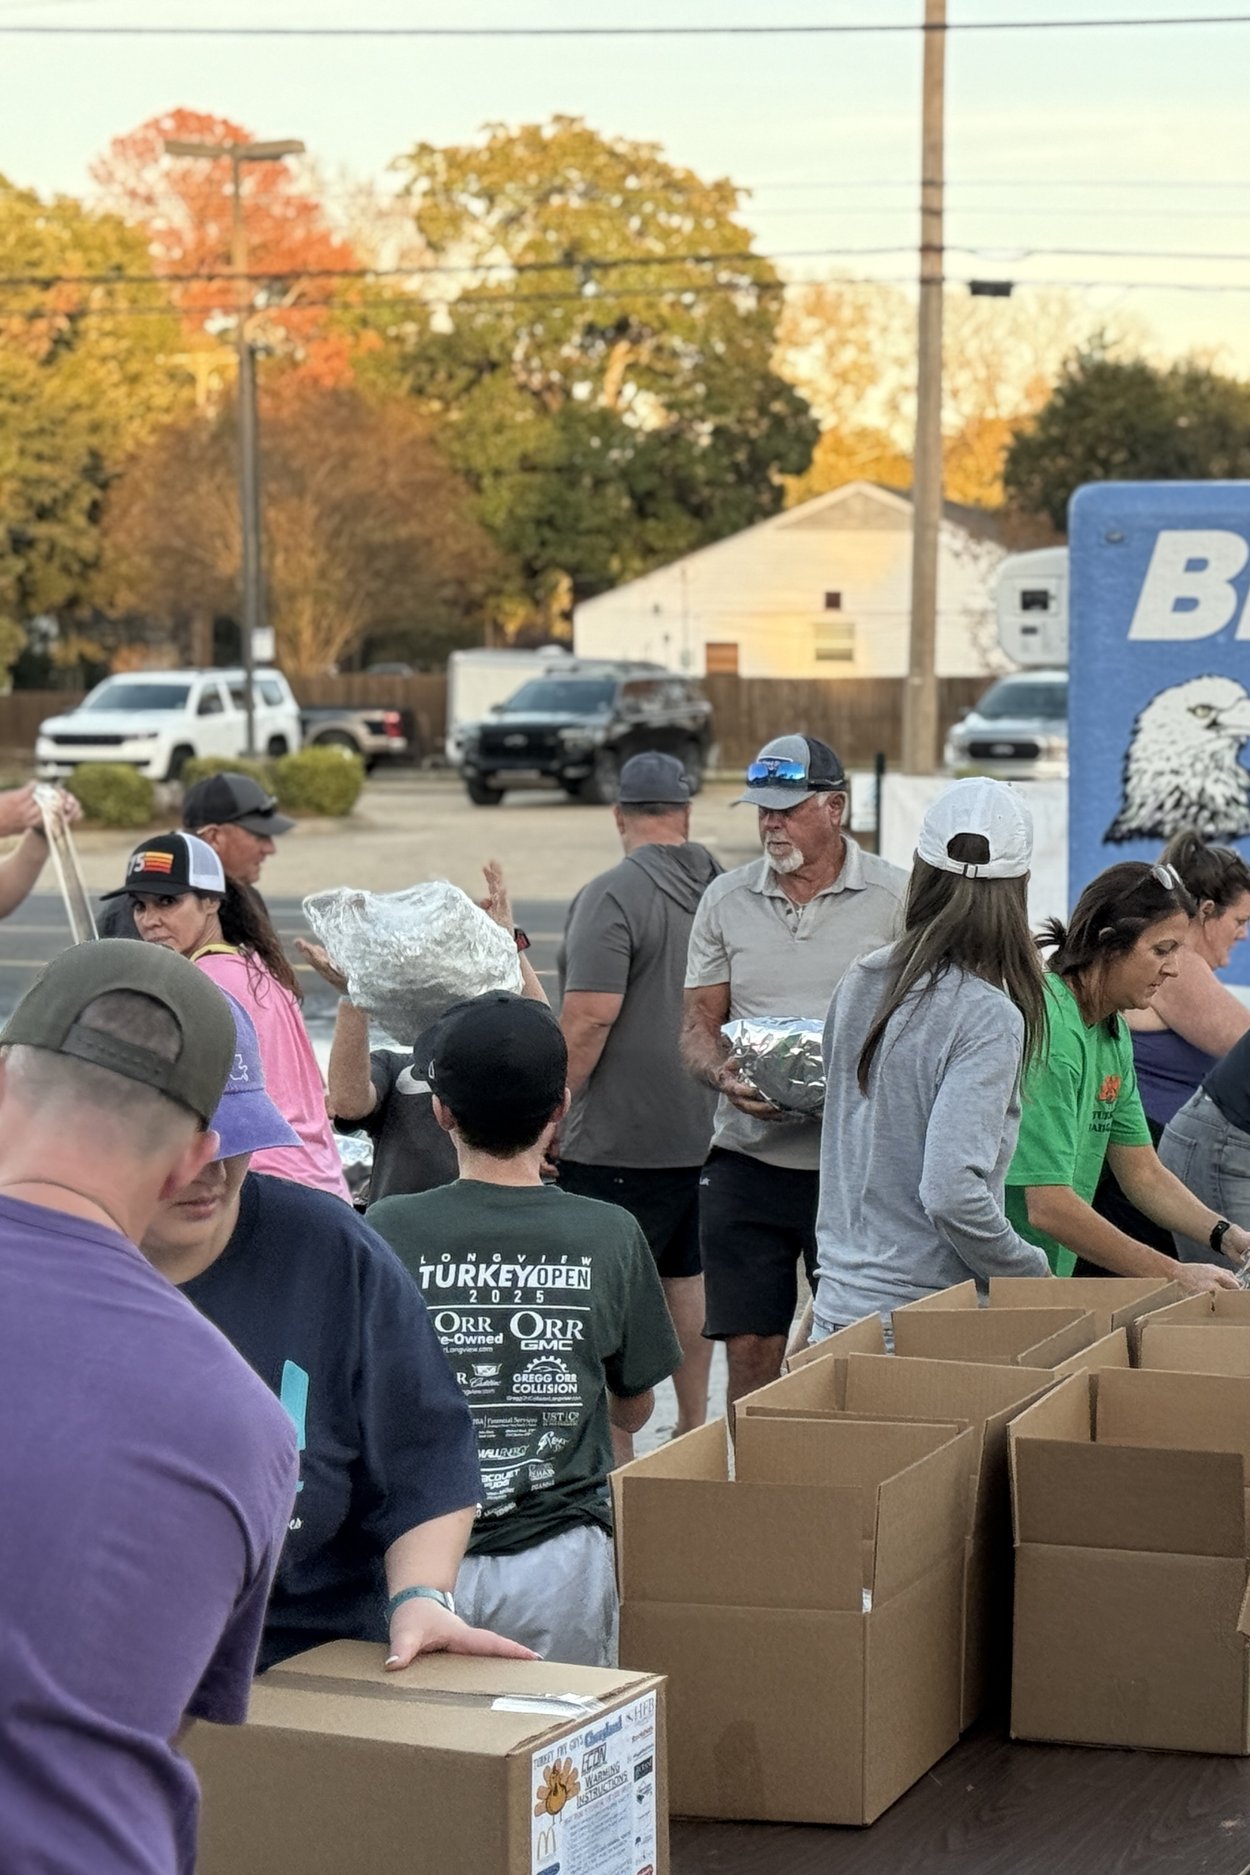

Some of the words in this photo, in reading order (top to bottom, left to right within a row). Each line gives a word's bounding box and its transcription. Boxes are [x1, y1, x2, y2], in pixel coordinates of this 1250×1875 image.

[420, 1253, 592, 1265] LONGVIEW
[419, 1264, 534, 1289] TURKEY
[536, 1266, 590, 1289] OPEN
[469, 1290, 544, 1303] 2025
[438, 1333, 503, 1345] e-Owned
[521, 1340, 573, 1350] GMC
[513, 1373, 552, 1383] GREGG
[555, 1373, 577, 1383] ORR
[512, 1384, 578, 1394] COLLISION
[577, 1771, 628, 1806] INSTRUCTIONS
